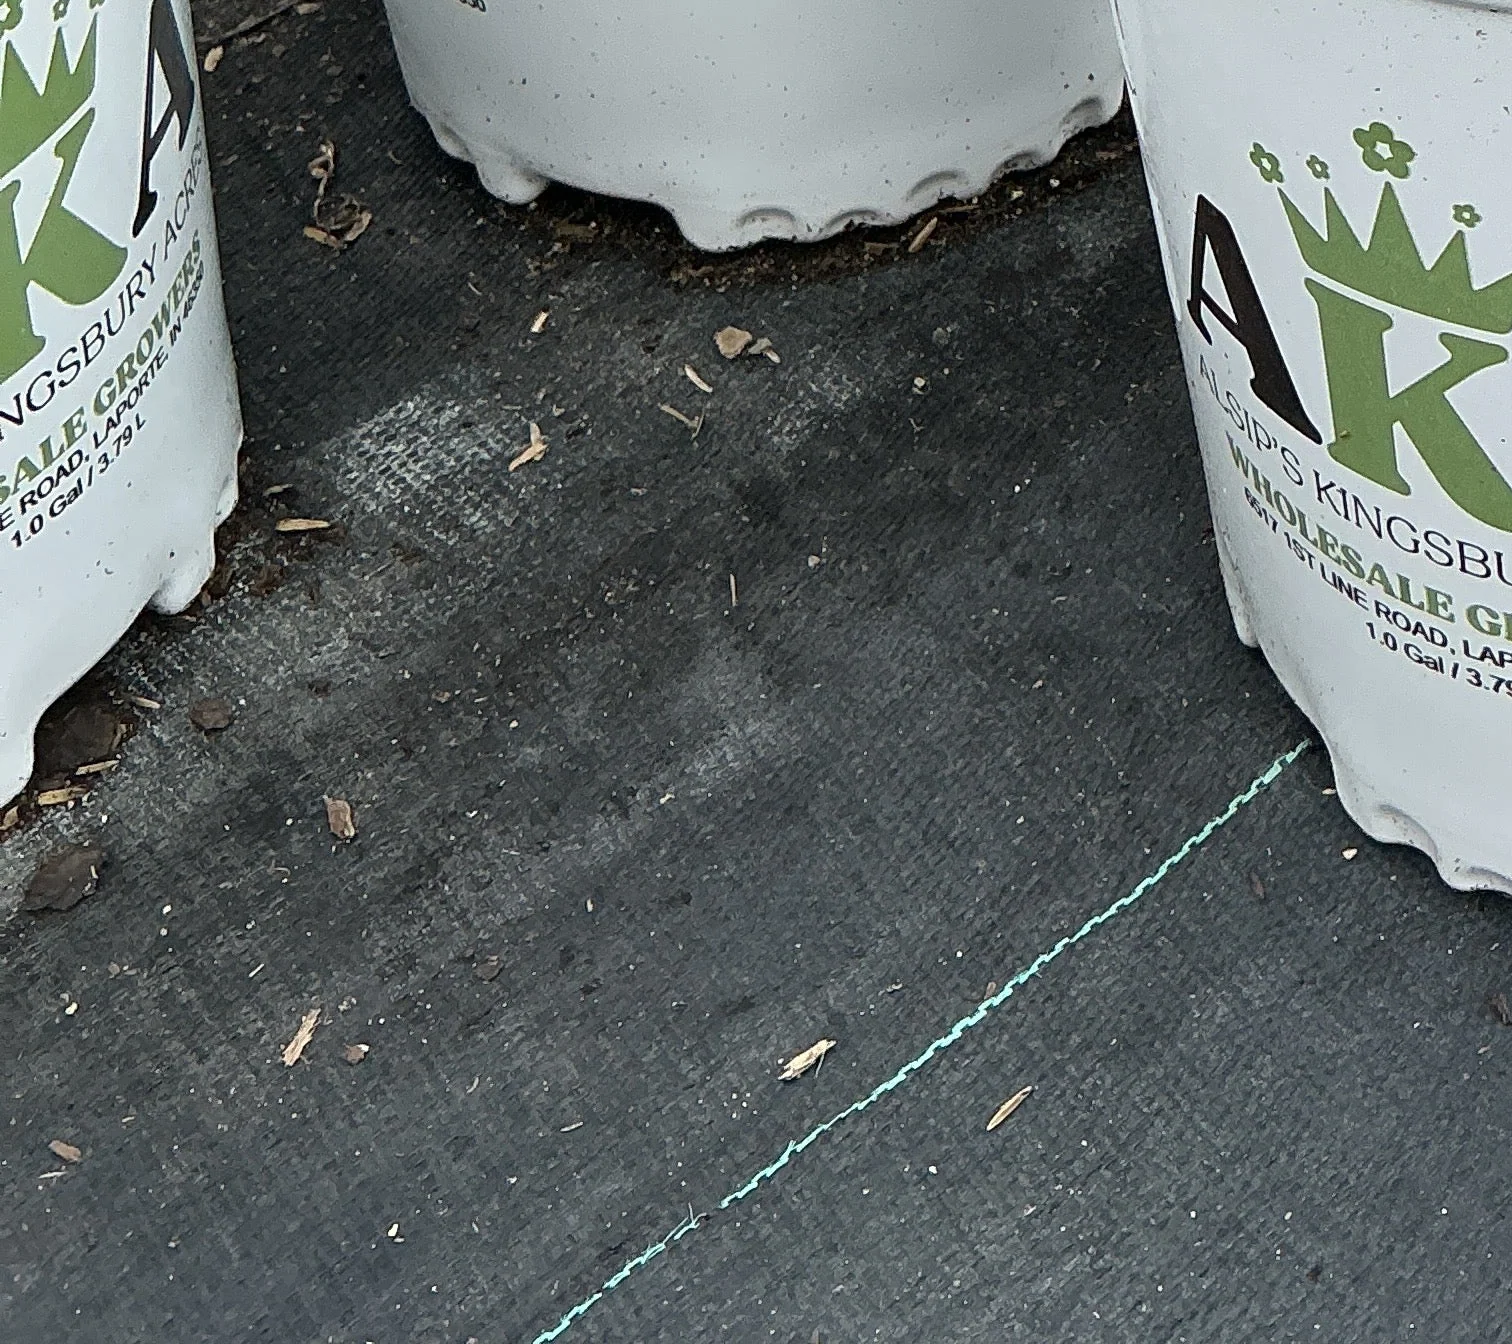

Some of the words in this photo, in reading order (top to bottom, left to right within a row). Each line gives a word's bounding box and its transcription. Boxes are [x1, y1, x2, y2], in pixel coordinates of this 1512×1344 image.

[93, 229, 202, 417] GROWERS
[11, 513, 44, 548] 1.0
[49, 478, 85, 519] Gal
[98, 424, 133, 475] 3.79
[135, 412, 147, 431] L
[18, 448, 91, 516] ROAD,
[92, 345, 169, 450] LAPORTE,
[168, 315, 183, 347] IN
[1199, 353, 1304, 486] ALSIP'S
[1225, 430, 1456, 623] WHOLESALE
[1283, 531, 1316, 570] 1ST
[1319, 562, 1370, 611] LINE
[1374, 599, 1456, 655] ROAD,
[1365, 621, 1399, 653] 1.0
[1404, 644, 1445, 675] Gal
